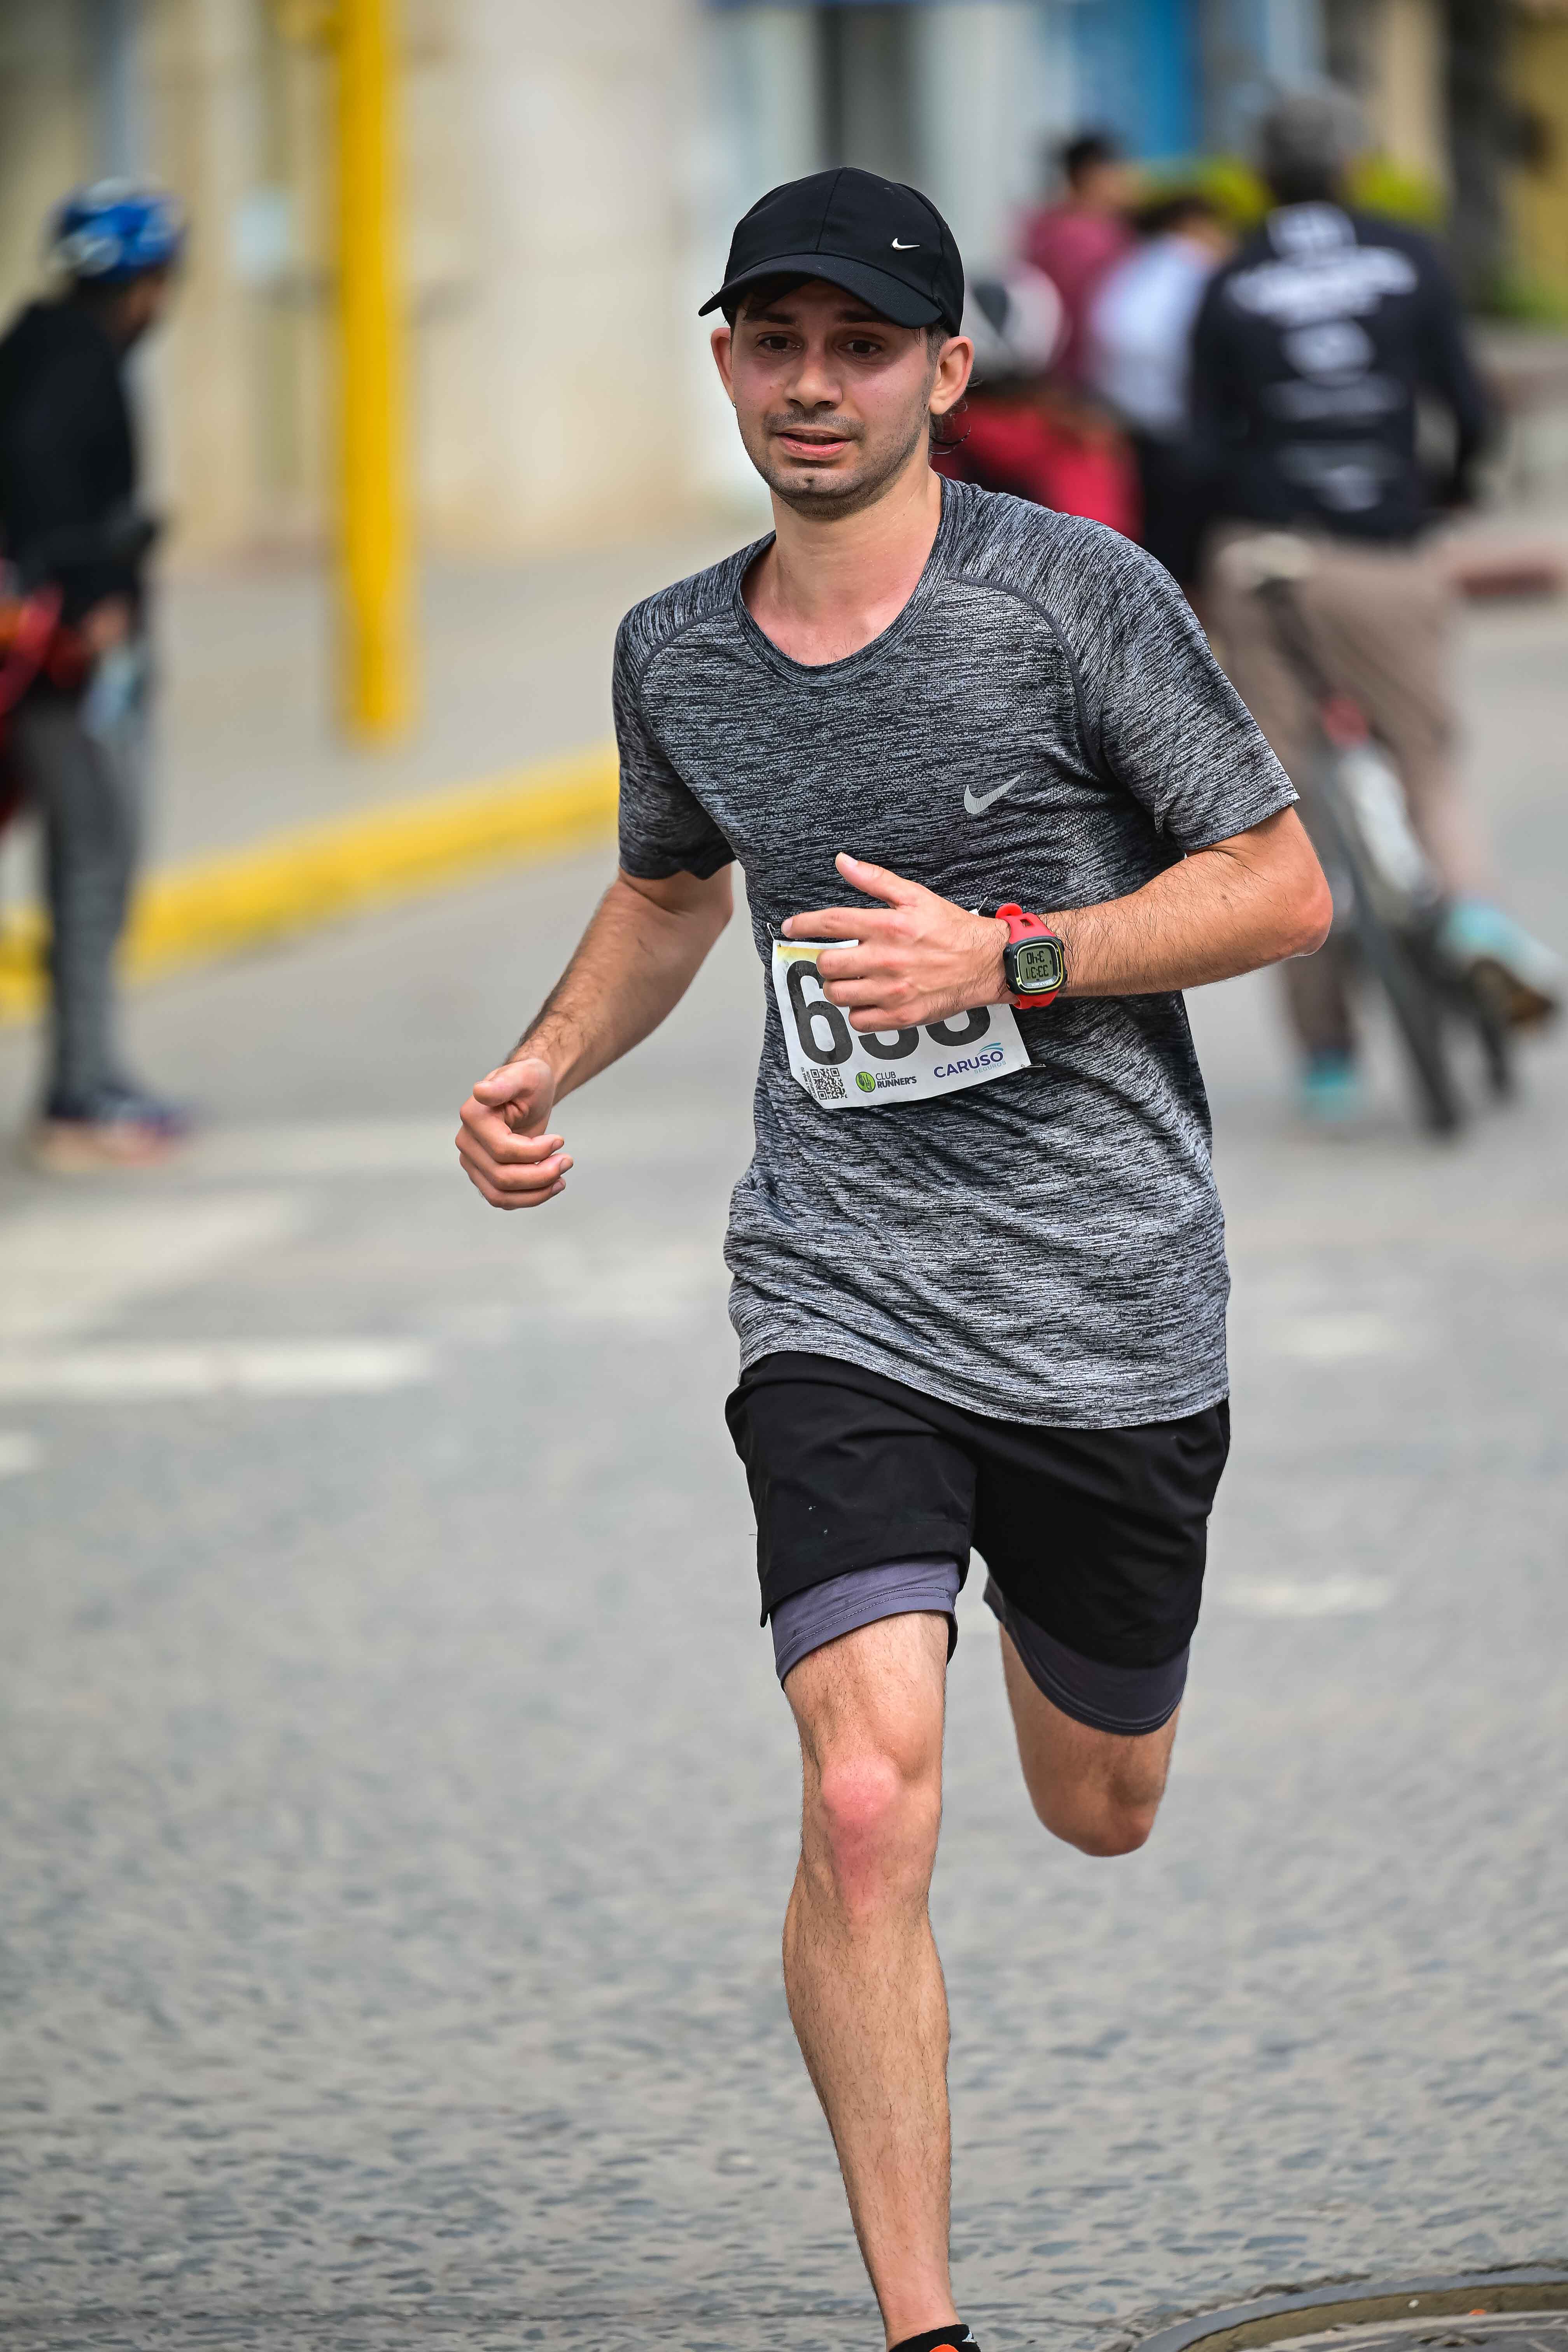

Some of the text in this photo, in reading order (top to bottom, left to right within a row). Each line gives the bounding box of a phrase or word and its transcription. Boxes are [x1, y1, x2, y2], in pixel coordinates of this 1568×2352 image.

[934, 1051, 1003, 1078] CARUSO
[974, 1060, 1006, 1074] SEGUROS
[875, 1071, 896, 1080] CLUB
[877, 1076, 917, 1088] RUNNER'S
